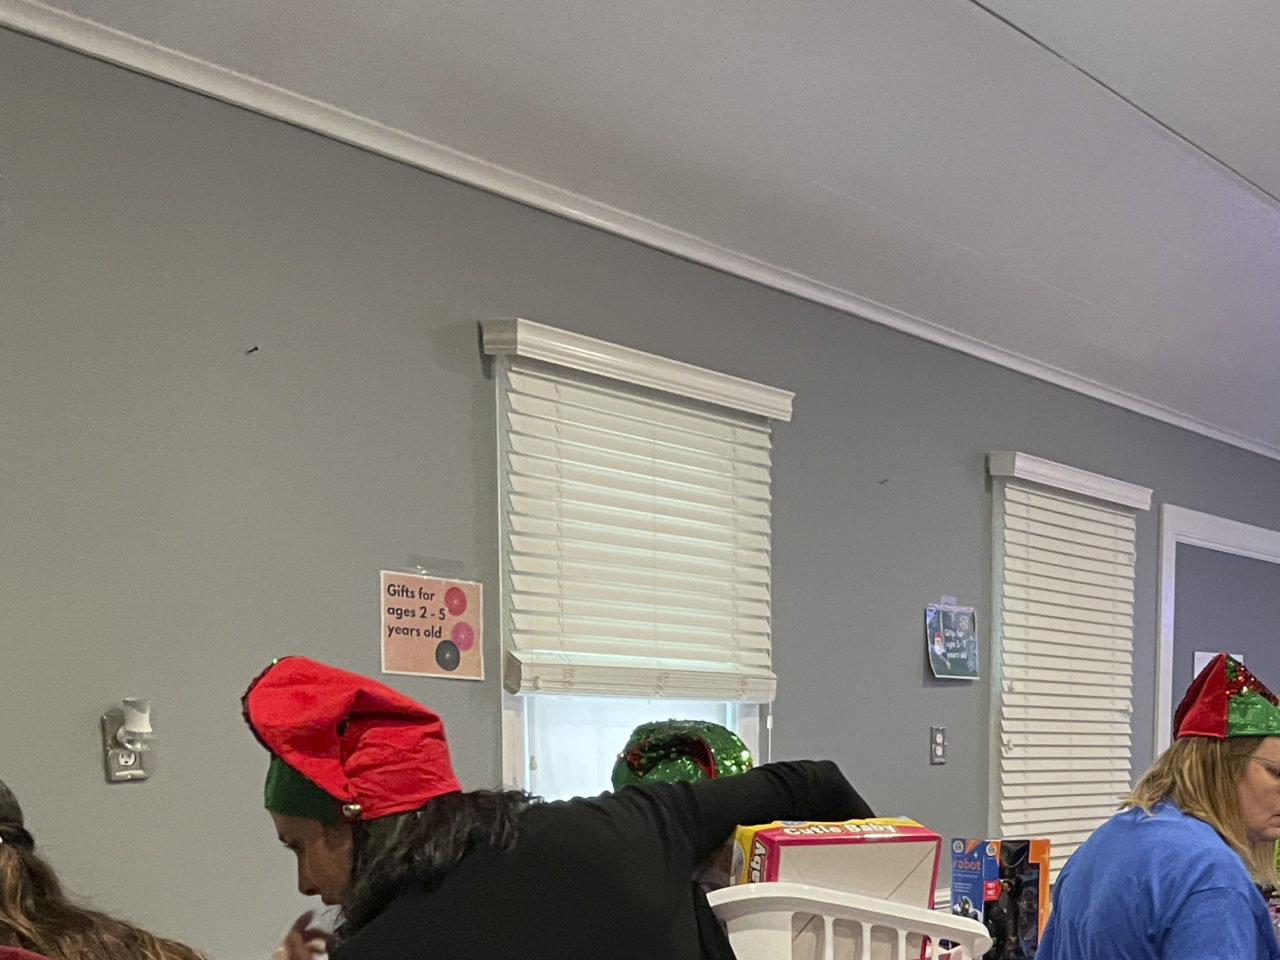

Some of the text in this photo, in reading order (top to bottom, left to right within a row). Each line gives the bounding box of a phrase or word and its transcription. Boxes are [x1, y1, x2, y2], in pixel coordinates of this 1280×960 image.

[387, 584, 435, 601] Gifts for
[387, 606, 416, 620] ages
[420, 606, 428, 619] 2
[438, 608, 446, 621] 5
[387, 625, 442, 639] years old
[783, 822, 897, 836] Cutie Baby
[750, 839, 766, 883] aby
[953, 858, 982, 871] robot
